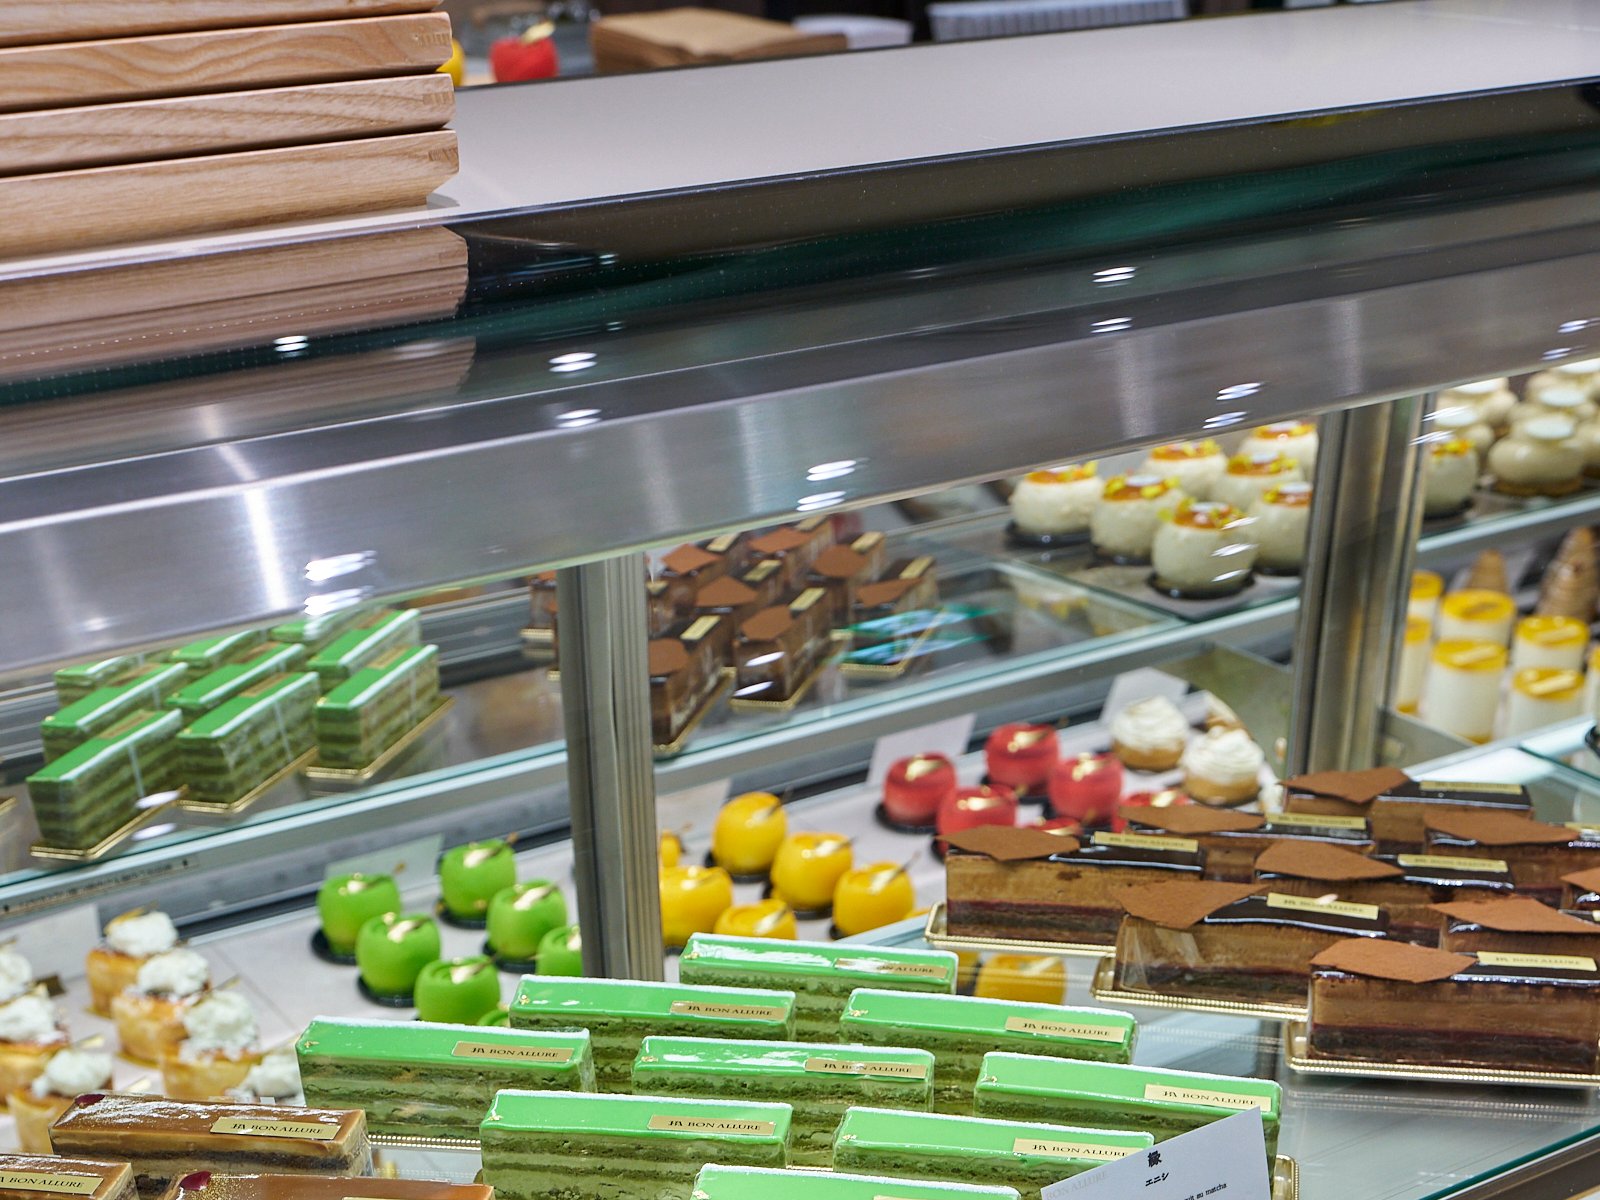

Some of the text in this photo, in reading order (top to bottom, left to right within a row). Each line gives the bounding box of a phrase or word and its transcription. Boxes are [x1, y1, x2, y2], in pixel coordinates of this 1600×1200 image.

[731, 1008, 773, 1016] ALLURE
[1068, 1027, 1110, 1036] ALLURE
[516, 1050, 559, 1058] ALLURE
[869, 1065, 912, 1073] ALLURE
[1182, 1093, 1210, 1101] BON
[1212, 1096, 1257, 1105] ALLURE
[251, 1124, 278, 1132] BON
[280, 1126, 324, 1135] ALLURE
[716, 1123, 761, 1131] ALLURE
[1082, 1148, 1128, 1157] ALLURE
[9, 1177, 37, 1185] BON
[39, 1179, 85, 1189] ALLURE
[1145, 1172, 1169, 1187] エニシ
[1205, 1182, 1228, 1196] matcha
